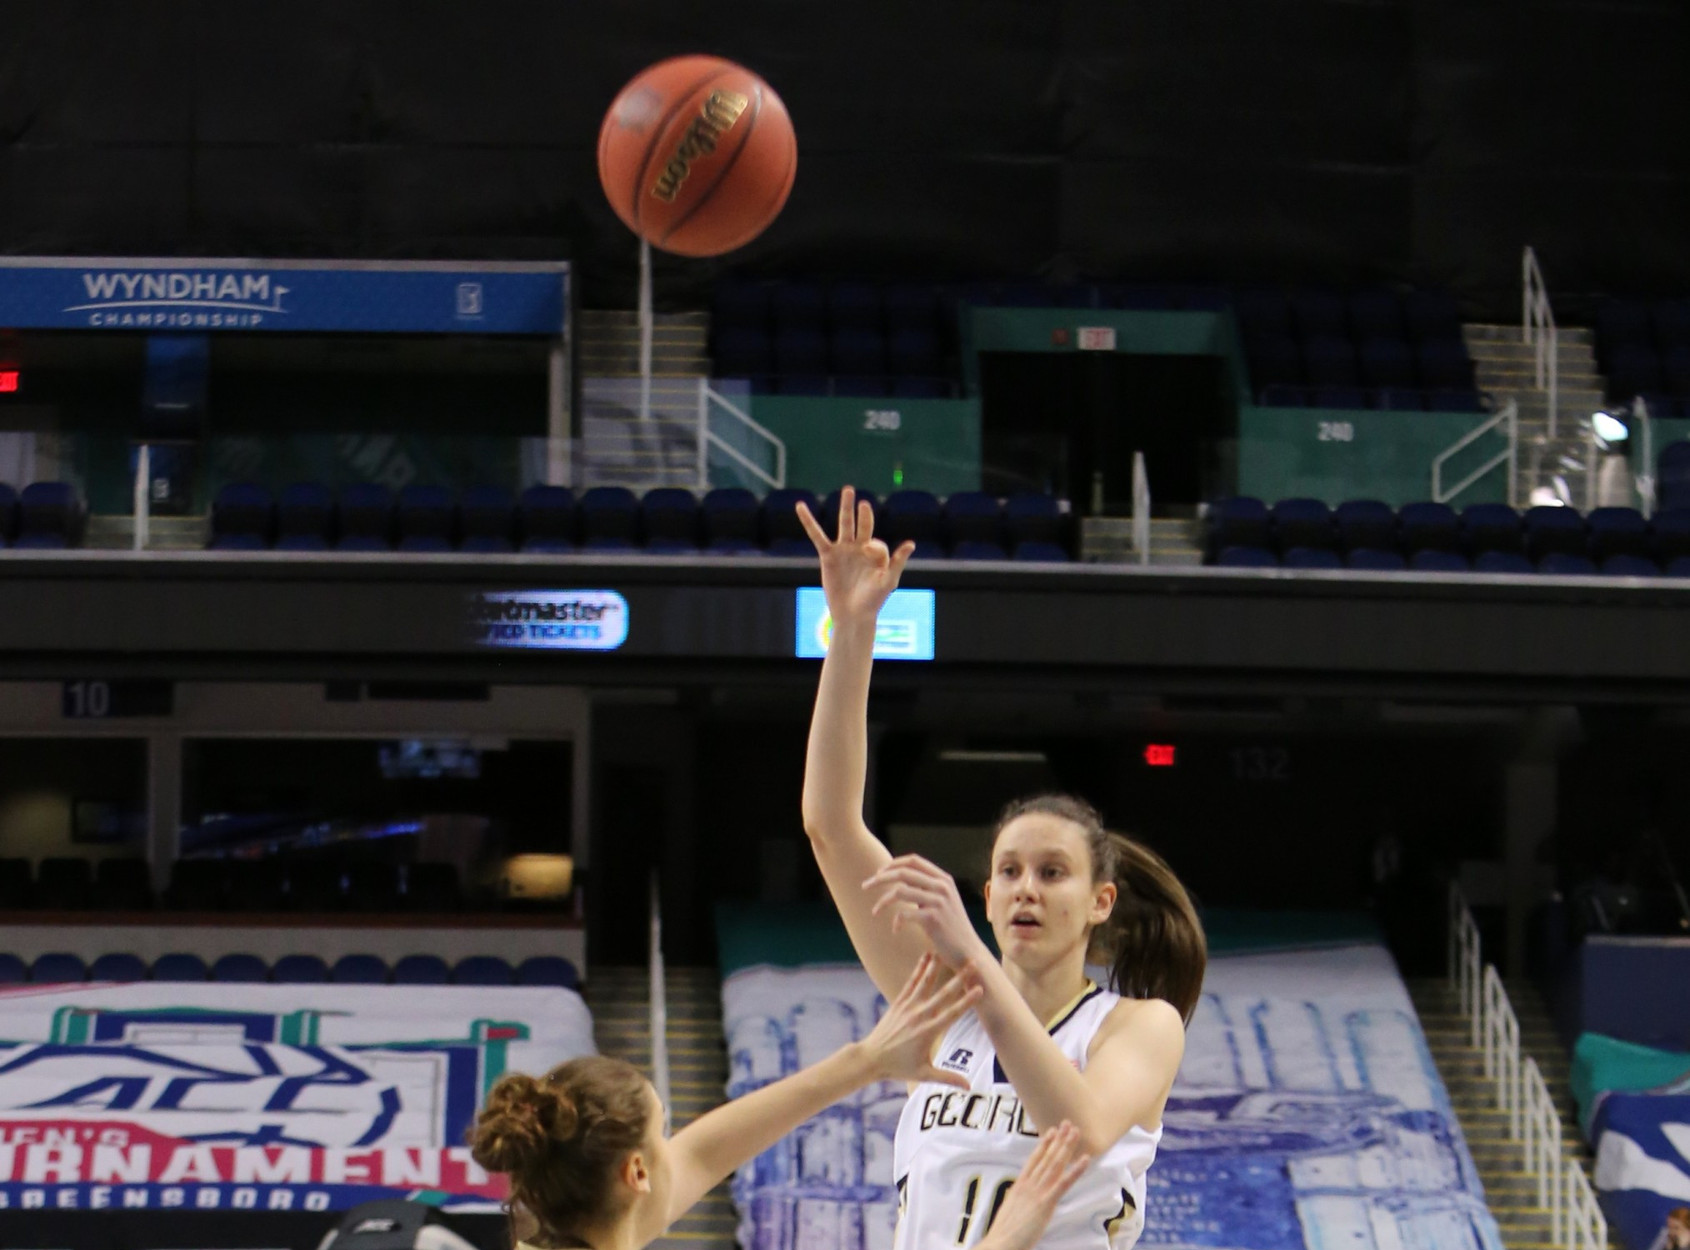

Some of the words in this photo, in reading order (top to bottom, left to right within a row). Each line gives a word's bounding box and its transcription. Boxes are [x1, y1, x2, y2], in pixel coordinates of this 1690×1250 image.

[82, 273, 271, 300] WYNDHAM
[88, 312, 263, 327] CHAMPIONSHIP
[68, 682, 110, 717] 10
[1230, 747, 1290, 779] 132
[0, 1185, 331, 1212] REENSBORO
